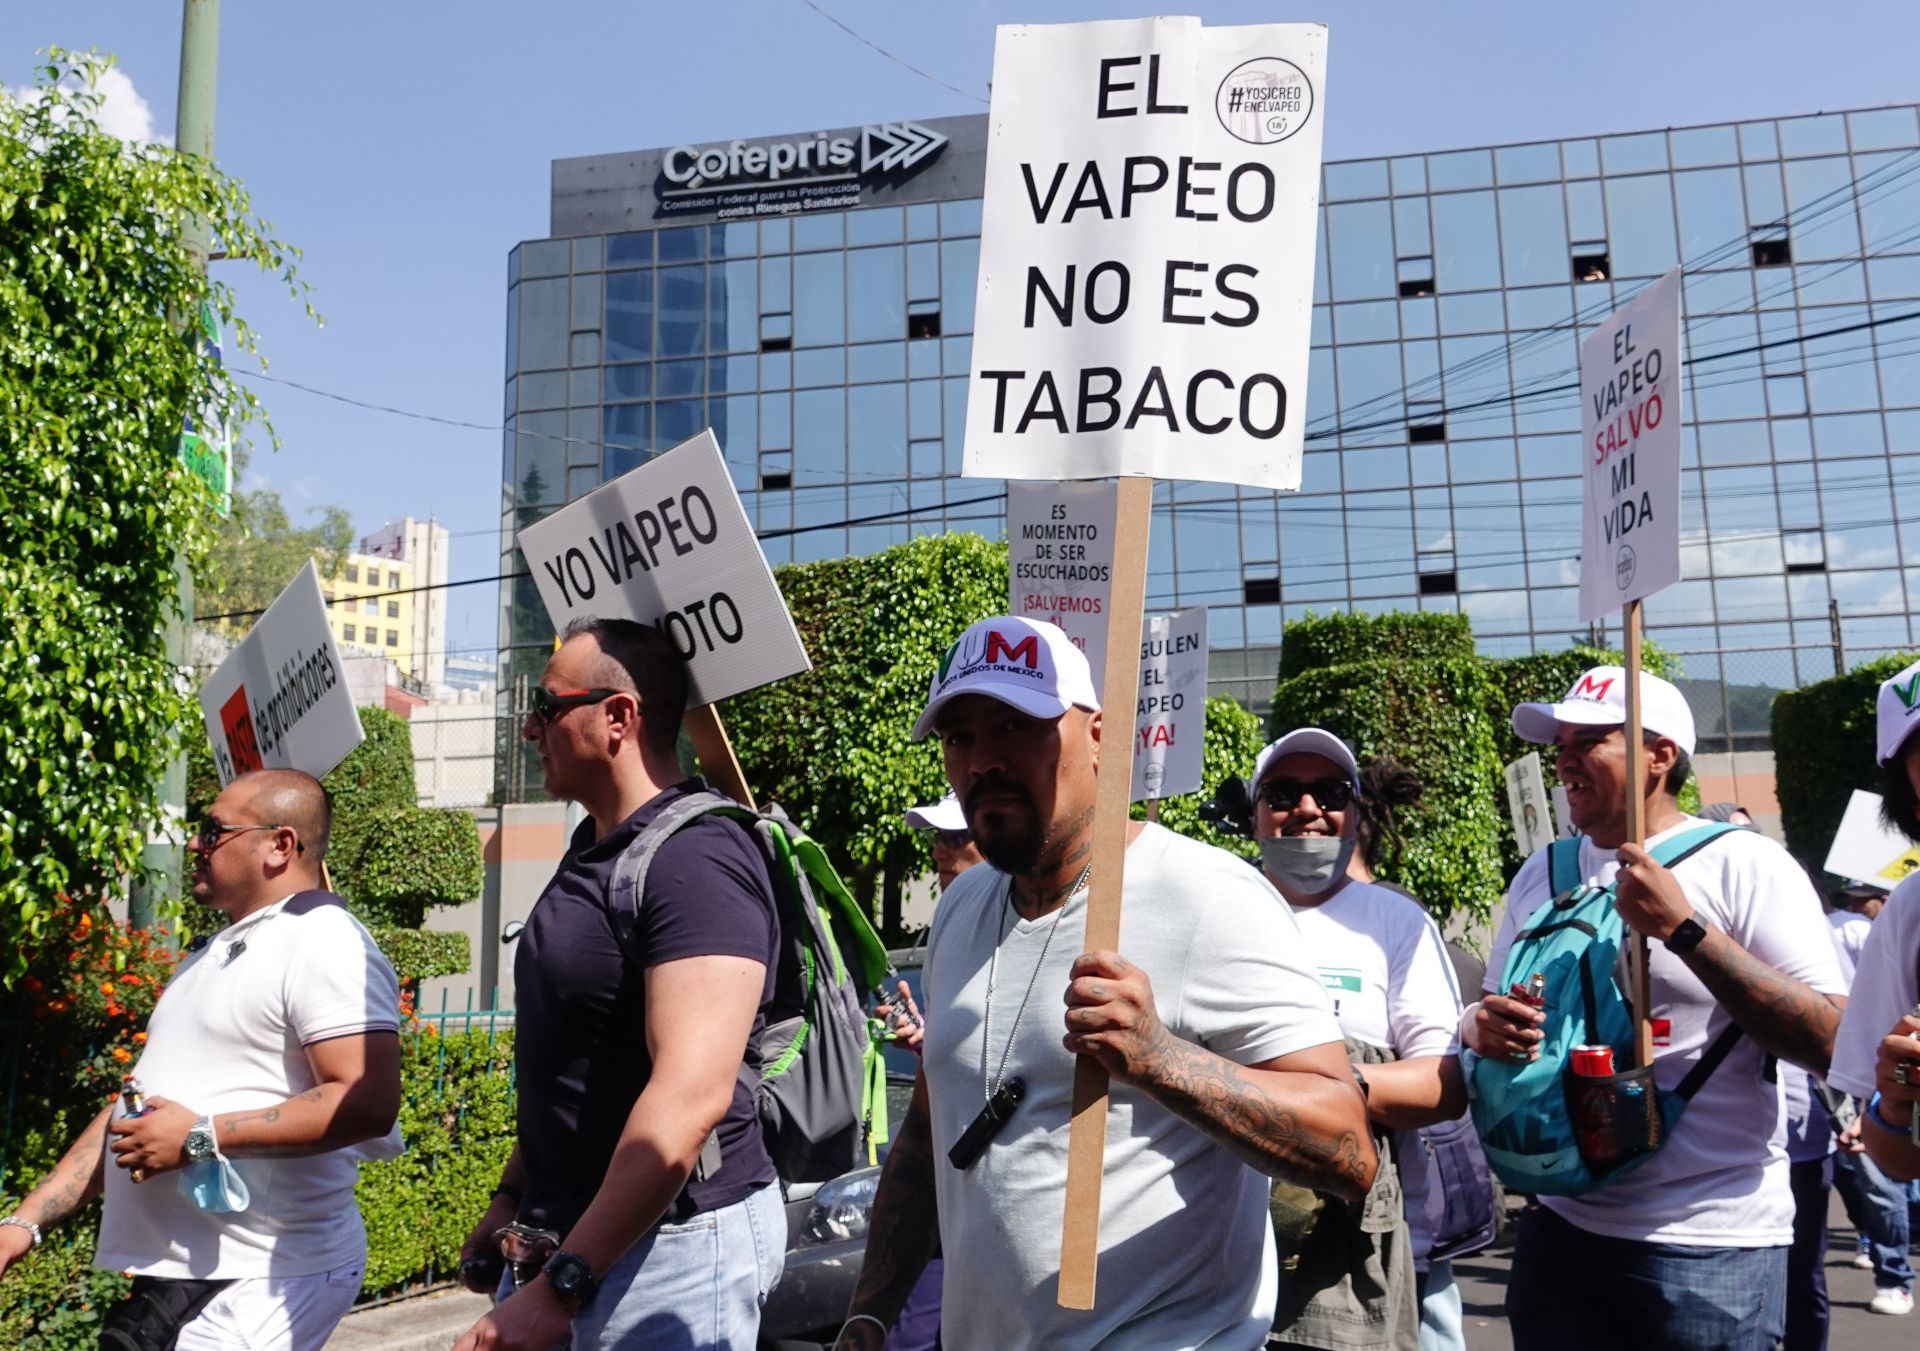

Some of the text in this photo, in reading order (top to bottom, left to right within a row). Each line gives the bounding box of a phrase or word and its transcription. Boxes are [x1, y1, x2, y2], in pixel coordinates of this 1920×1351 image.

[1097, 54, 1189, 119] EL
[1229, 87, 1301, 106] #YOSICREO
[1244, 101, 1301, 112] ENELVAPEO
[662, 131, 857, 187] Cofepris
[716, 193, 758, 205] Federal
[759, 192, 785, 203] para
[786, 189, 797, 199] la
[718, 195, 860, 218] contra Riesgos Sanitarios
[1020, 156, 1275, 224] VAPEO
[1024, 260, 1260, 328] NO ES
[1613, 324, 1637, 365] EL
[1593, 348, 1662, 422] VAPEO
[980, 366, 1287, 440] TABACO
[1596, 384, 1663, 465] SALVÓ
[1611, 453, 1636, 497] MI
[1051, 504, 1066, 520] ES
[1603, 490, 1654, 545] VIDA
[544, 485, 718, 608] YO VAPEO
[1022, 524, 1097, 540] MOMENTO
[1035, 545, 1086, 561] DE SER
[1016, 563, 1109, 582] ESCUCHADOS
[1023, 594, 1102, 614] ¡SALVEMOS
[655, 591, 743, 661] OTO
[1140, 633, 1199, 660] GULEN
[959, 664, 991, 679] UNIDOS
[993, 664, 1006, 672] DE
[1007, 665, 1044, 679] MEXICO
[1144, 669, 1164, 686] EL
[253, 698, 273, 756] de
[268, 642, 336, 758] prohibiciones
[1137, 693, 1184, 717] APEO
[1136, 723, 1175, 757] ¡YA!
